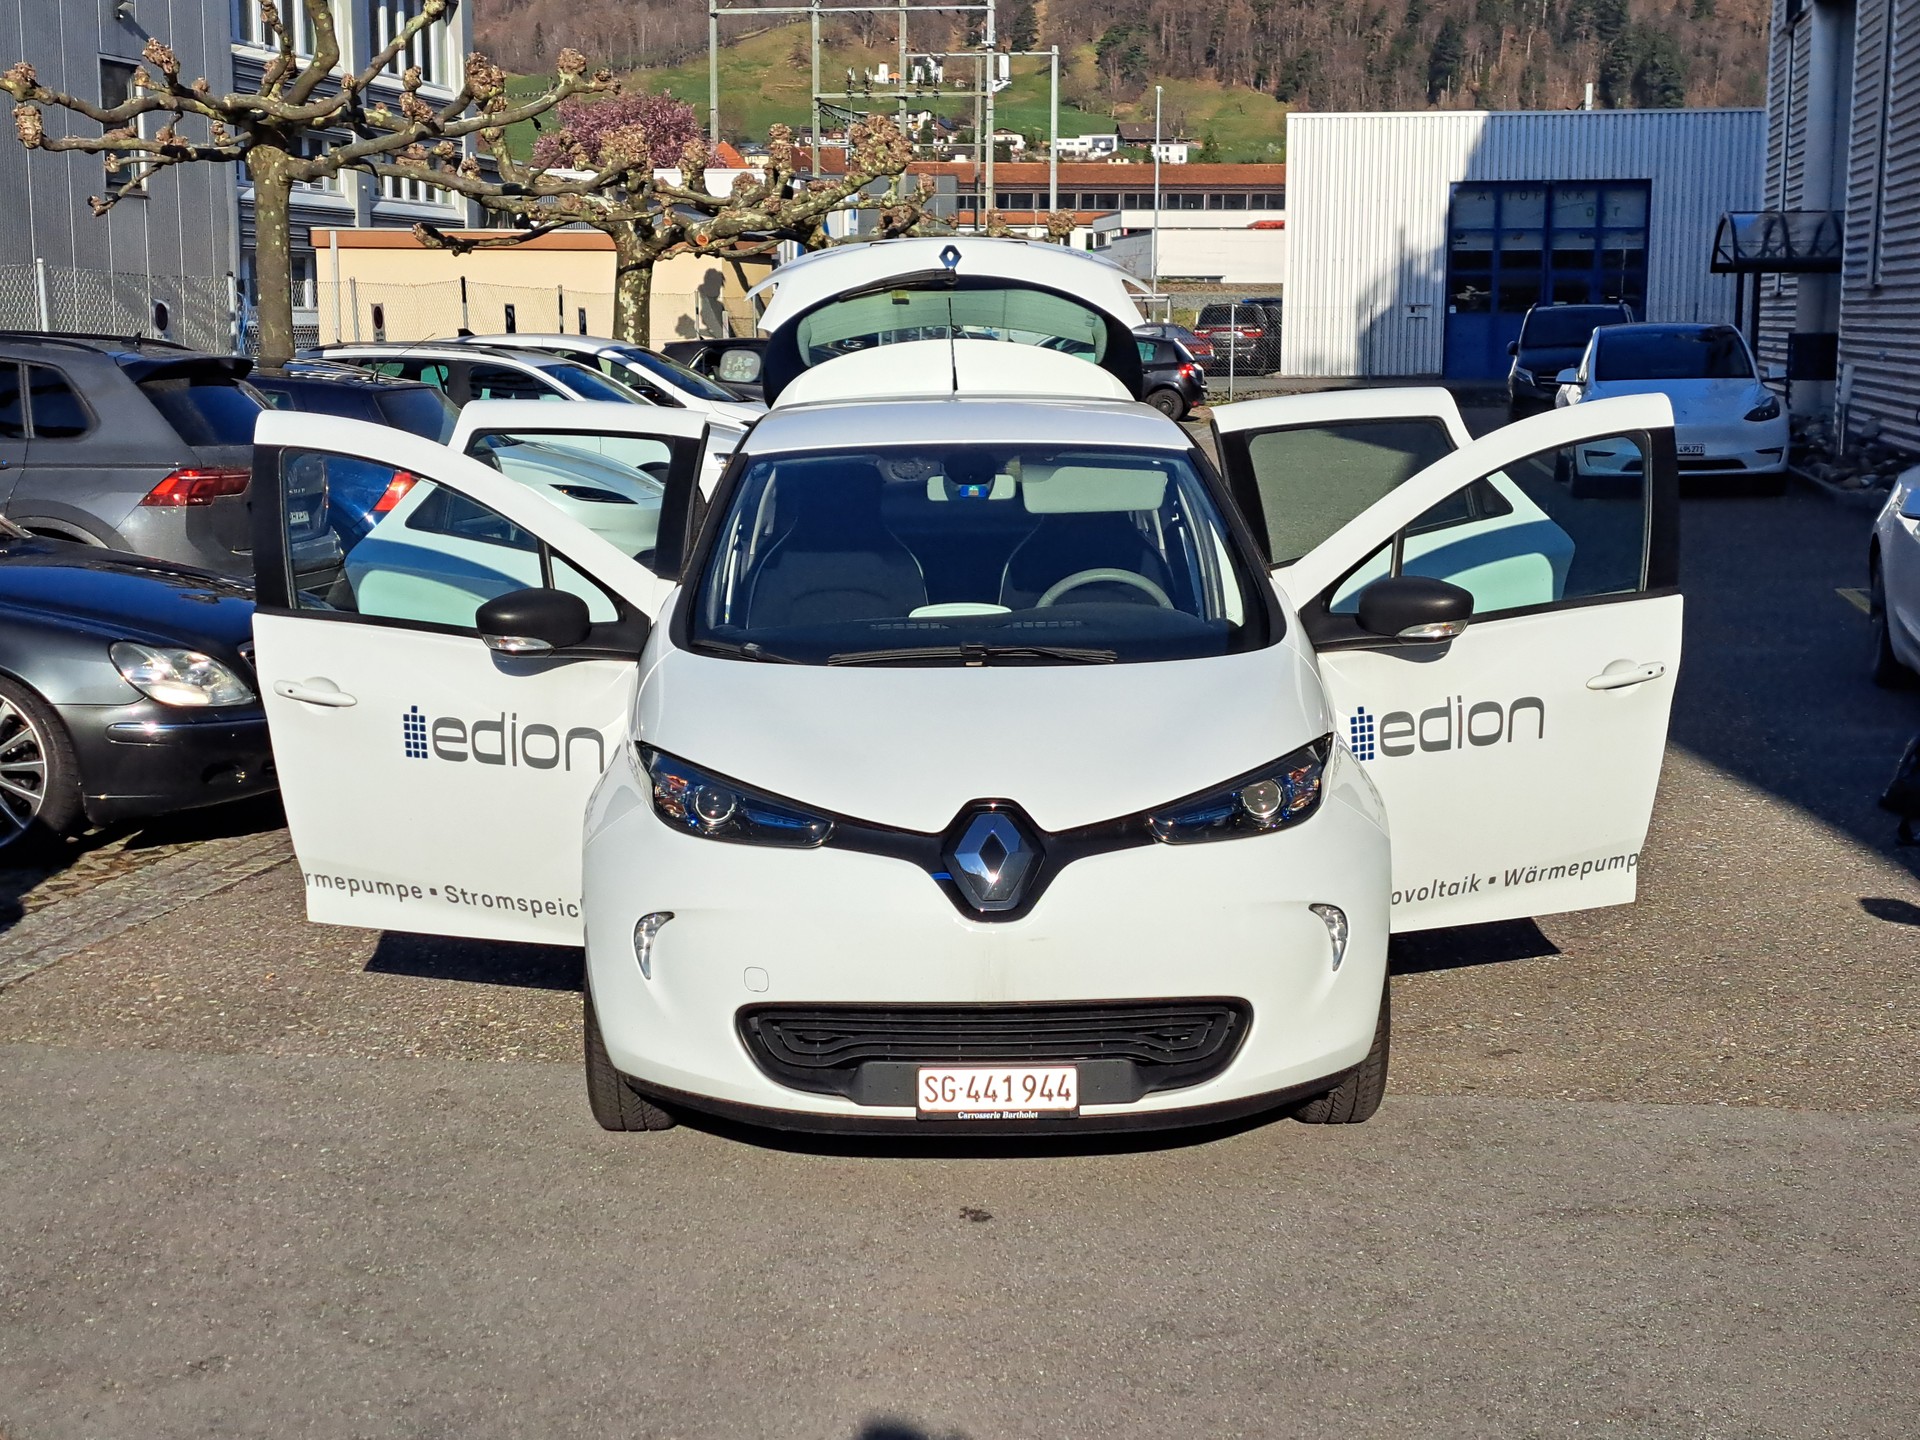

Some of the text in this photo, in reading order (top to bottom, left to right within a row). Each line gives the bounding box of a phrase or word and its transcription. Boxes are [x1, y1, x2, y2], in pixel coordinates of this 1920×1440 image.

[432, 712, 605, 774] edion
[1380, 695, 1545, 757] edion
[444, 885, 582, 918] Stromspeic
[957, 1111, 1038, 1119] Carrosserie Bartholet
